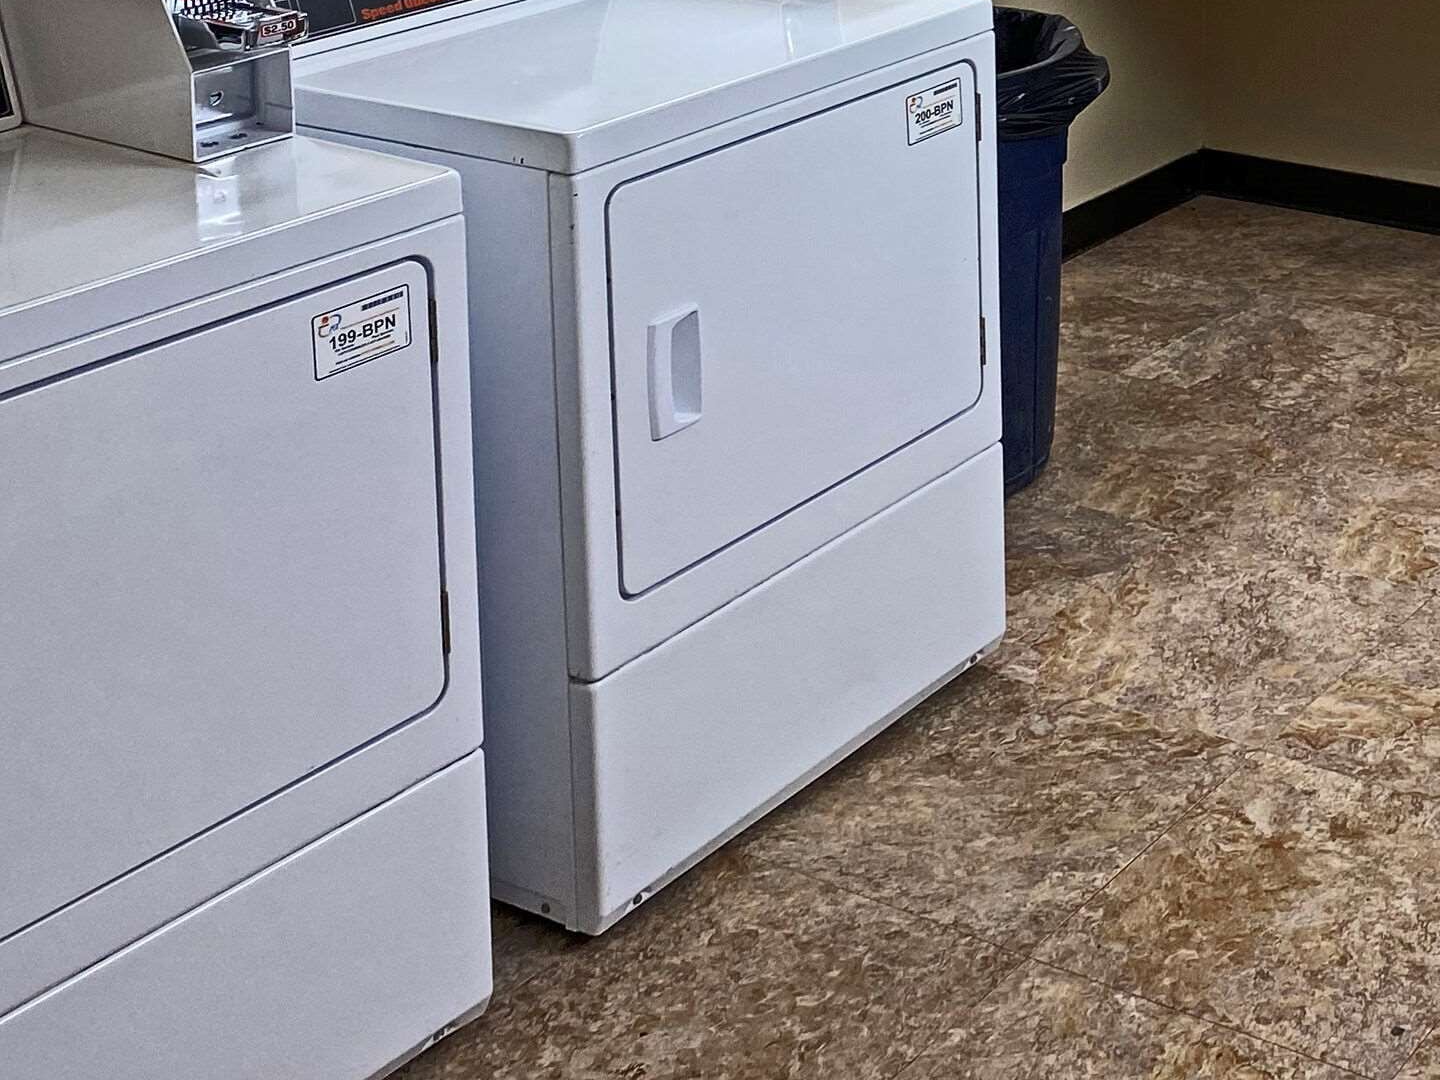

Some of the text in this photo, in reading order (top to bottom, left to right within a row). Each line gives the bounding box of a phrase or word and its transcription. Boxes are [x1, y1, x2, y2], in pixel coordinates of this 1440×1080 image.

[361, 0, 402, 20] Speed
[915, 100, 954, 124] 200-BPN
[329, 314, 396, 350] 199-BPN
